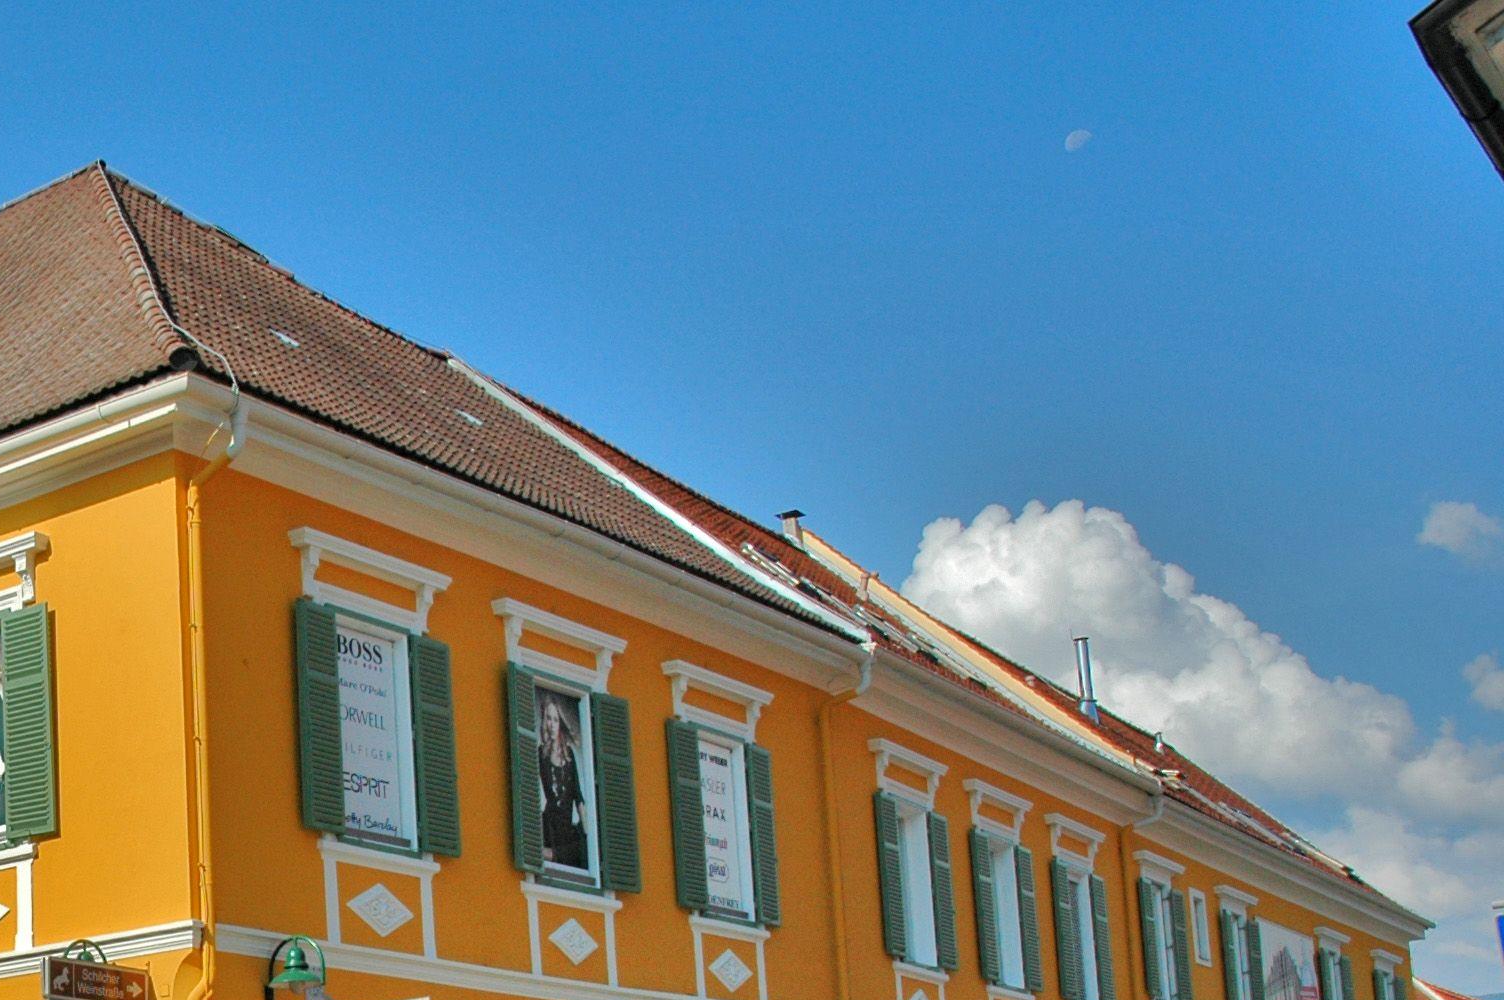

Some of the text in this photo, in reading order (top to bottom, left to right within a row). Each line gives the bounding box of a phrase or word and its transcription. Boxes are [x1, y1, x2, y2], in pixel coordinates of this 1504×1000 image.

[337, 634, 382, 665] BOSS
[342, 771, 389, 799] ESPRIT
[82, 968, 120, 984] Schilcher
[78, 982, 124, 999] Weinstraße
